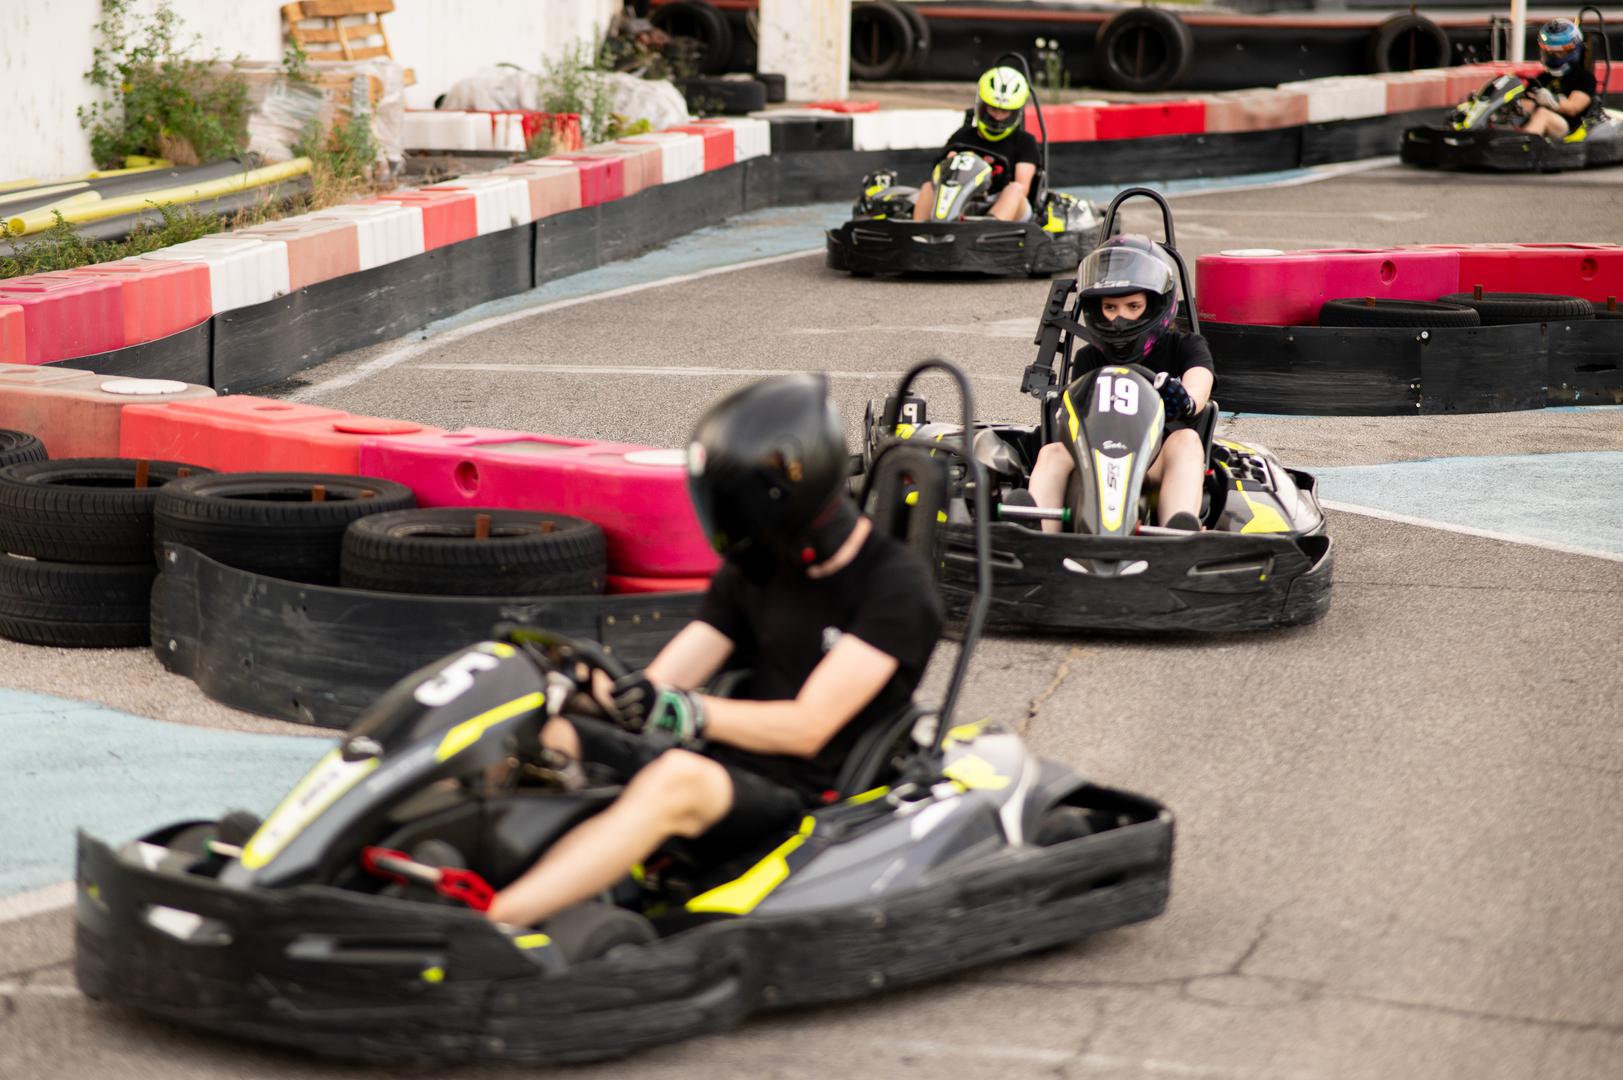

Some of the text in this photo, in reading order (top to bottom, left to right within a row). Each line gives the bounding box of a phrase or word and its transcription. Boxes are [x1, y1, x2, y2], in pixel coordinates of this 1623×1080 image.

[949, 154, 976, 171] 13
[1096, 376, 1139, 416] 19
[413, 651, 500, 707] 5
